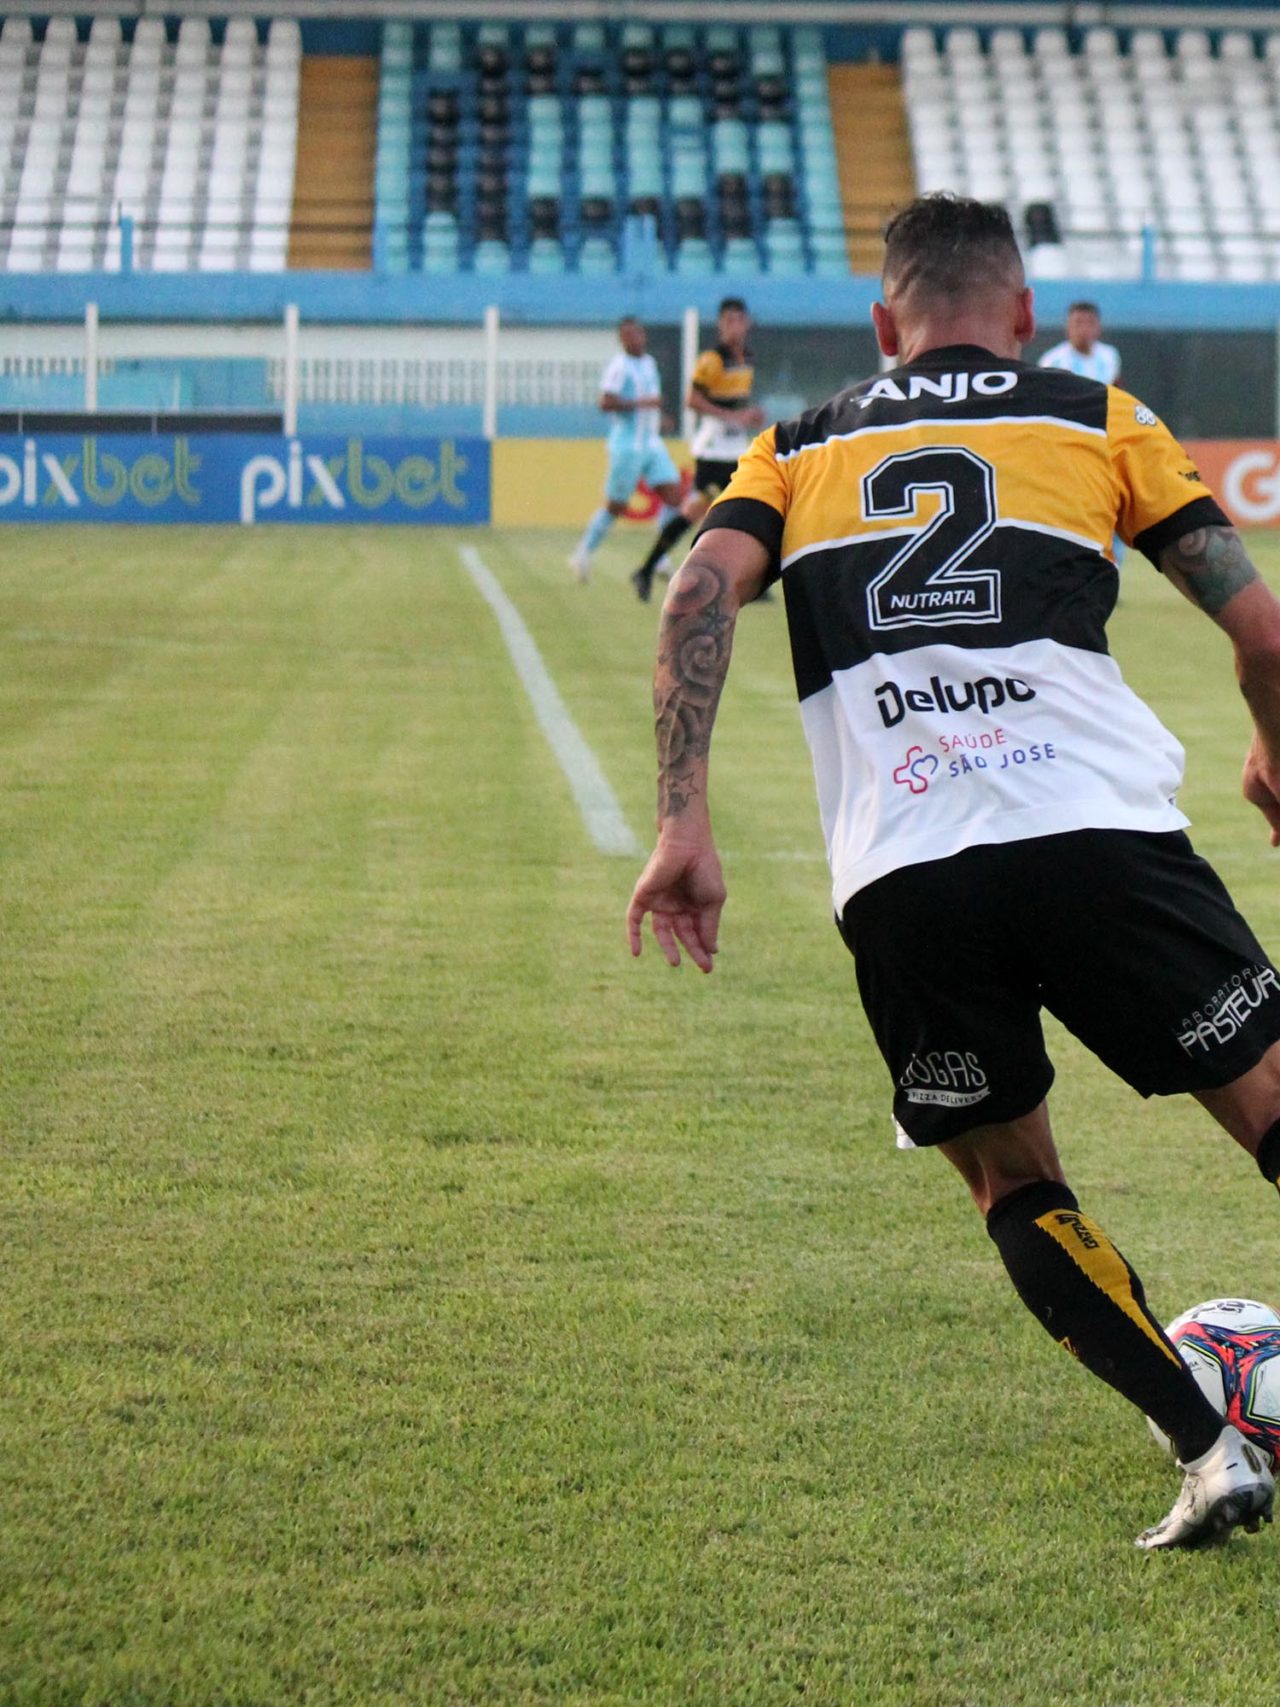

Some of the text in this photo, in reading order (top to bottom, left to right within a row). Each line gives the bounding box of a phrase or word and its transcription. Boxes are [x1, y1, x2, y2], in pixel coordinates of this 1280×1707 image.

[849, 371, 1018, 409] ANJO
[240, 435, 469, 524] pixbet
[862, 446, 1001, 630] 2
[890, 589, 976, 609] NUTRATA
[874, 676, 1037, 729] Delupo
[938, 728, 1007, 753] SAÚDE
[949, 754, 988, 778] SÃO
